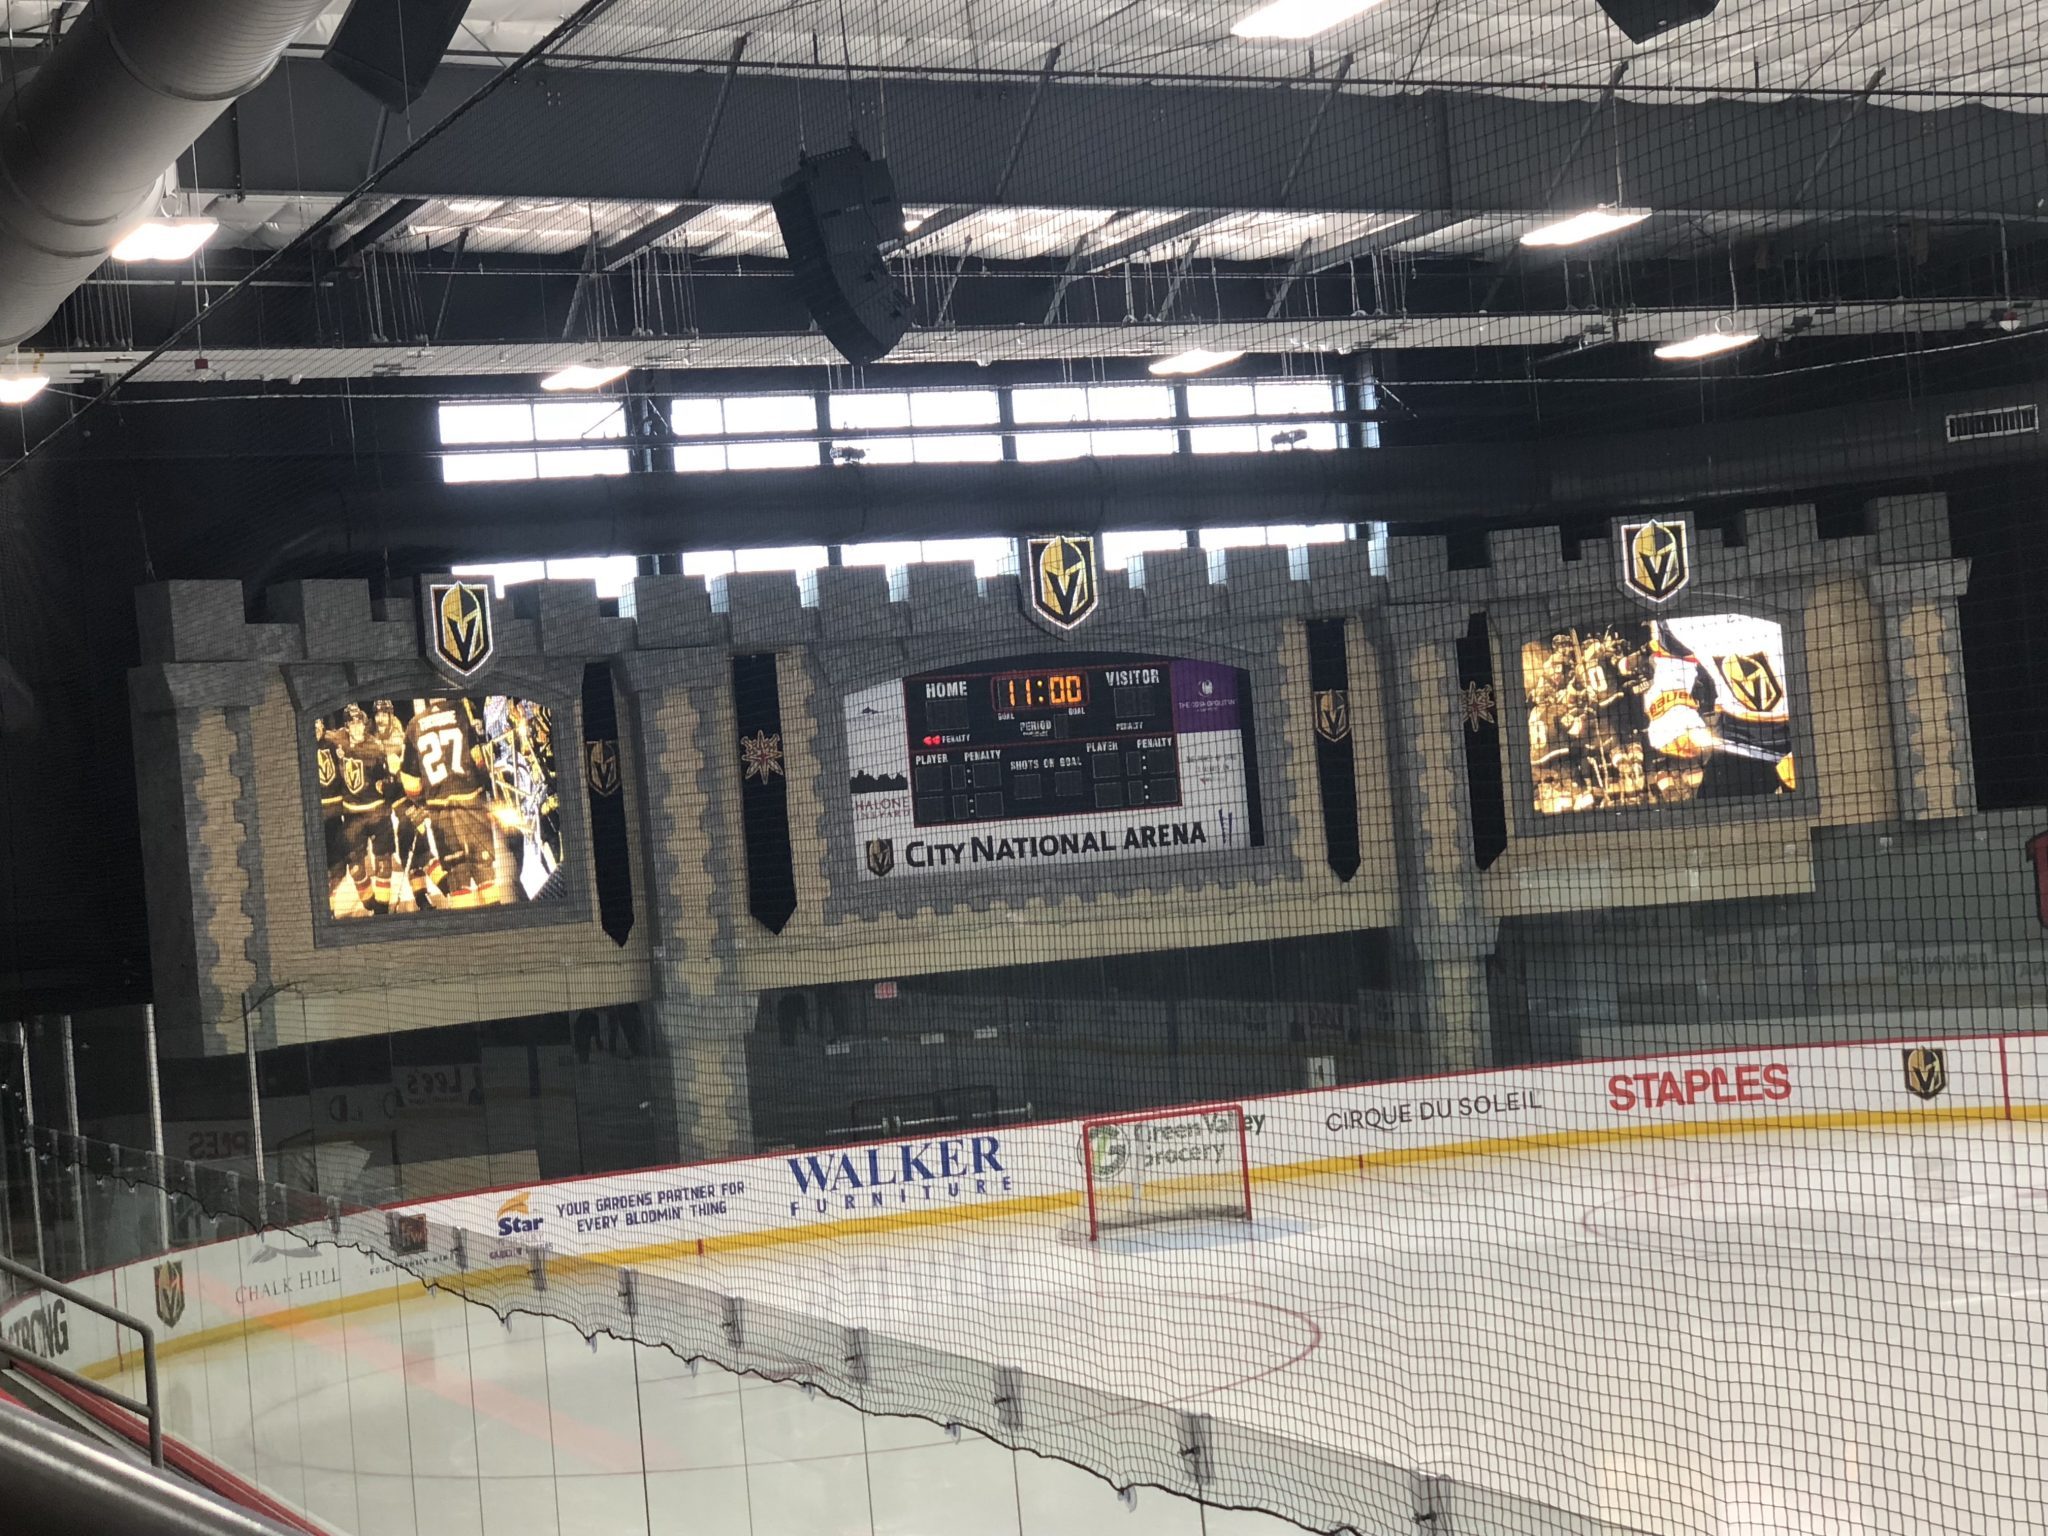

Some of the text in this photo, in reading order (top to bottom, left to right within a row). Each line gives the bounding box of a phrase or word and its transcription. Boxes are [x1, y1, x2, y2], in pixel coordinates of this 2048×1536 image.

[1105, 669, 1160, 686] VISITOR
[926, 681, 968, 698] HOME
[1008, 674, 1083, 707] 11:00
[997, 712, 1015, 721] GOAL
[1068, 707, 1086, 716] GOAL
[1019, 720, 1052, 732] PERIOD
[1117, 722, 1144, 732] PENALTY
[942, 734, 971, 744] PENALTY
[1086, 742, 1119, 753] PLAYER
[1137, 737, 1172, 749] PENALTY
[417, 727, 465, 787] 27
[915, 753, 948, 765] PLAYER
[964, 750, 1001, 762] PENALTY
[1010, 755, 1083, 771] SHOTS ON GOAL
[905, 821, 1207, 868] CITY NATIONAL ARENA
[1607, 1063, 1792, 1112] STAPLES
[1325, 1090, 1542, 1132] CIRQUE DU SOLEIL
[1203, 1111, 1266, 1136] Valey
[786, 1135, 1005, 1195] WALKER
[556, 1181, 745, 1218] YOUR GARDENS PARTNER FOR
[790, 1176, 1013, 1217] FURNITURE
[498, 1215, 544, 1236] Star
[577, 1215, 619, 1233] EVERY
[691, 1201, 727, 1218] THING
[235, 1266, 342, 1304] CHALK HILL
